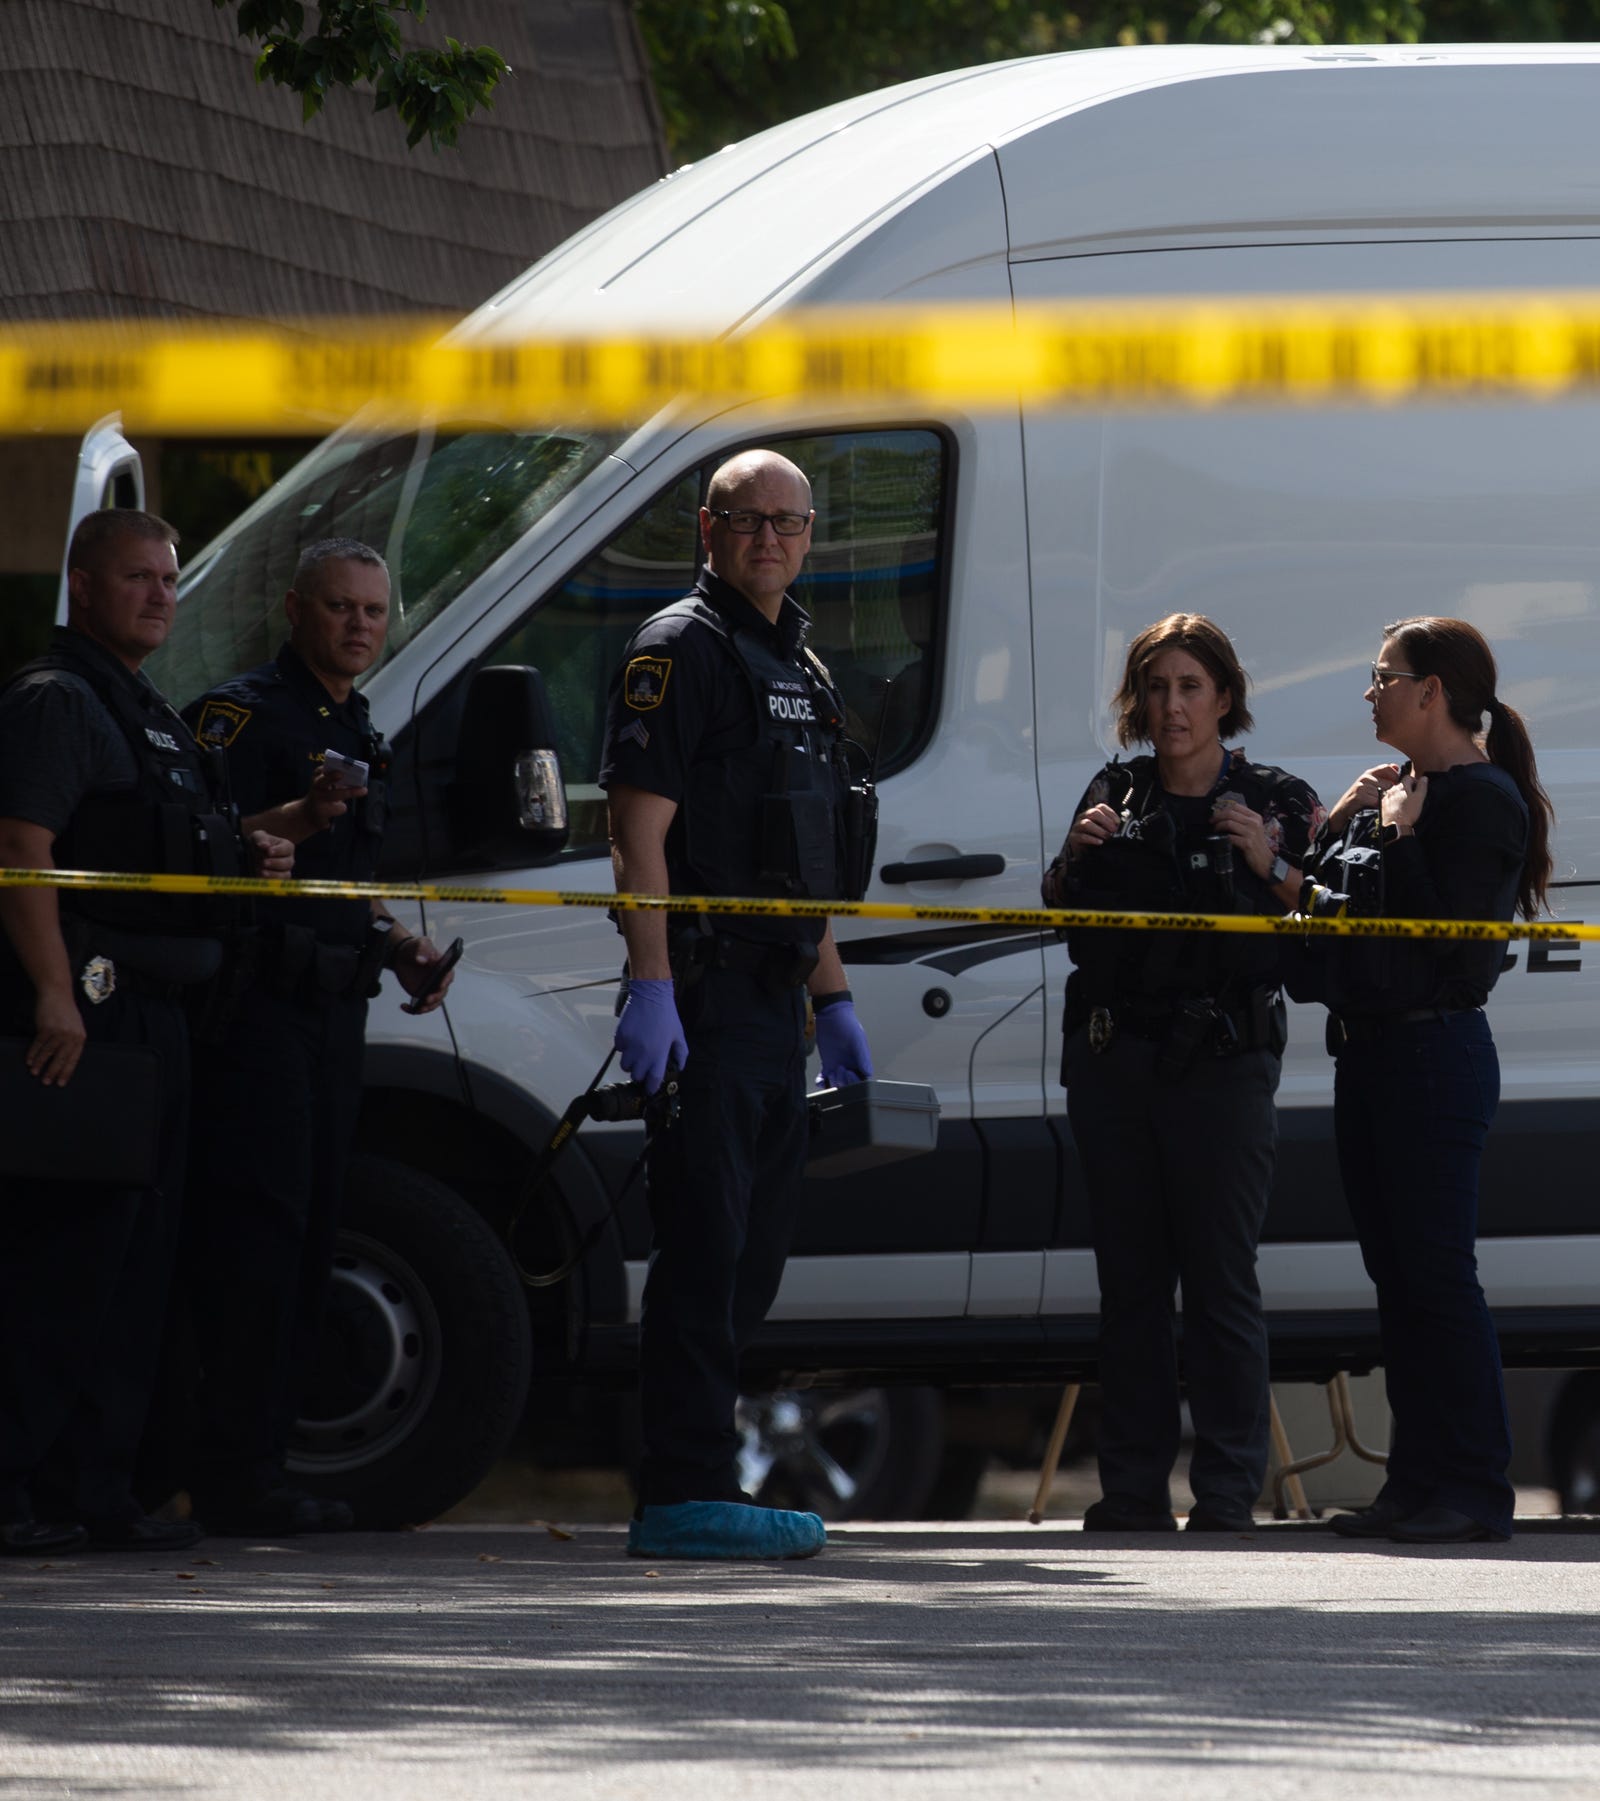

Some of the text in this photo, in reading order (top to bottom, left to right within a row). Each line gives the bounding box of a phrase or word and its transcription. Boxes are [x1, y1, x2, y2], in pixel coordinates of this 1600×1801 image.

[629, 693, 659, 703] POLICE
[768, 695, 816, 721] POLICE
[144, 727, 181, 752] POLICE
